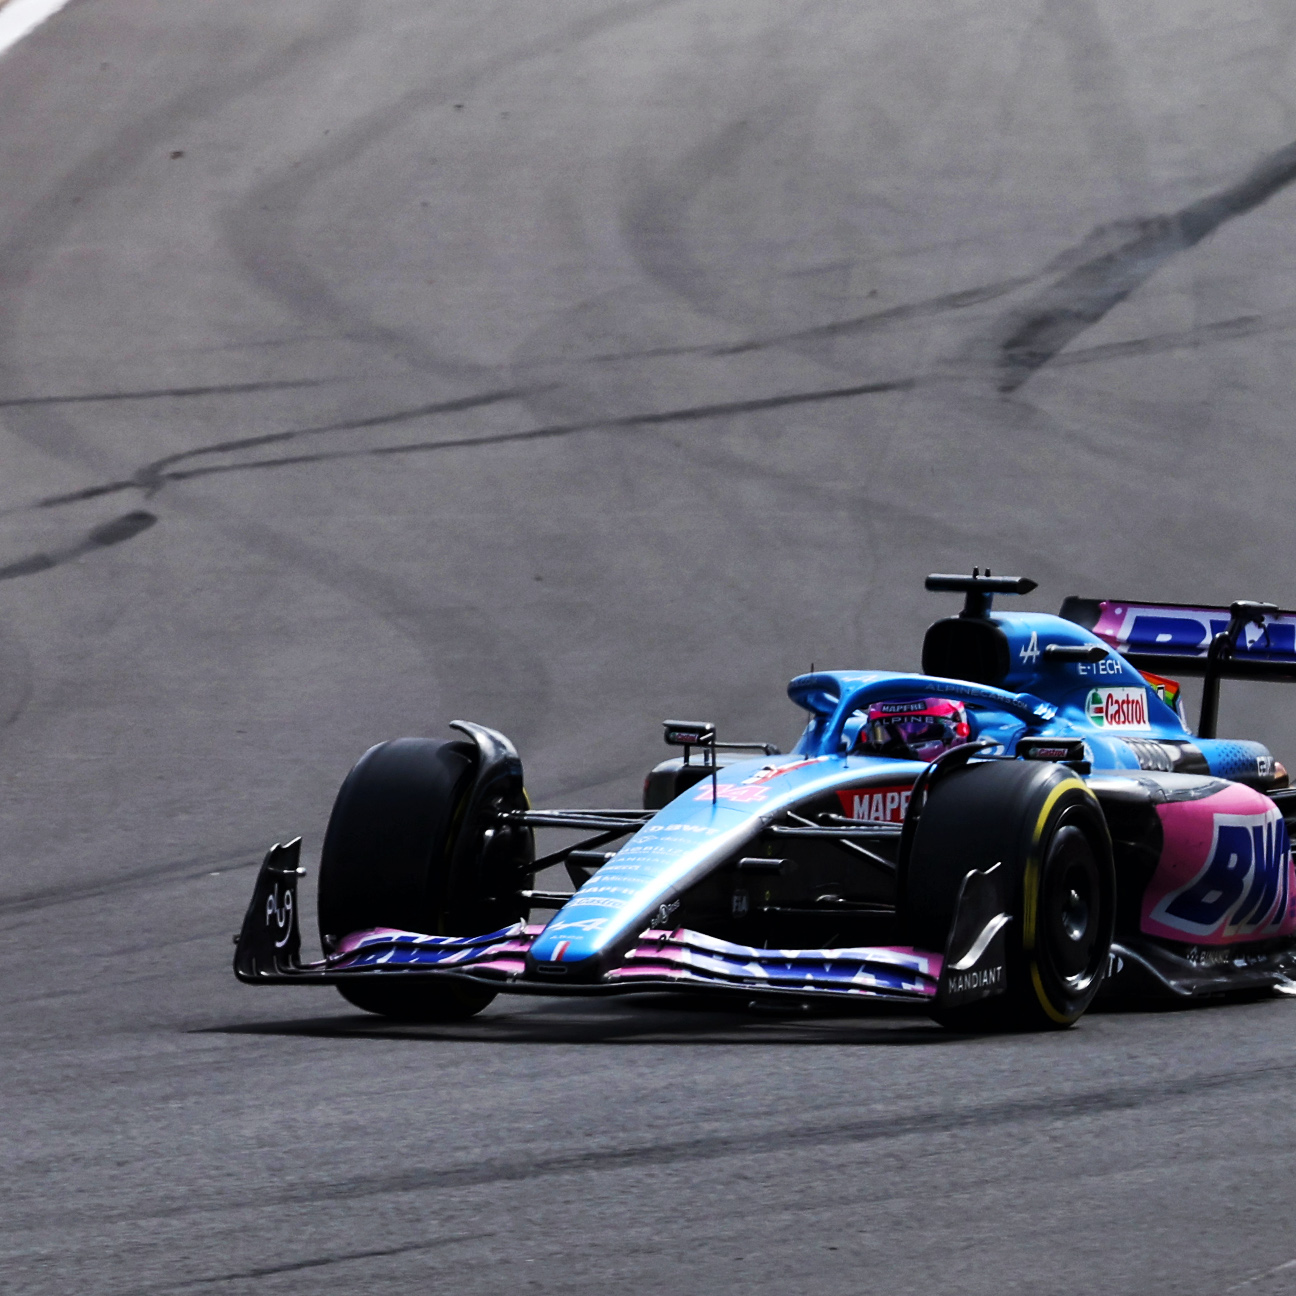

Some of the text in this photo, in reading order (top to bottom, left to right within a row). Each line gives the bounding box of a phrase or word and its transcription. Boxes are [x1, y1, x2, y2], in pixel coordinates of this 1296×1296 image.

[874, 716, 934, 727] ALPINE
[881, 703, 926, 713] MAPFRE
[1105, 693, 1147, 725] Castrol
[853, 790, 927, 821] MAPF
[1164, 816, 1291, 926] BWT
[949, 967, 1002, 994] MANDIANT
